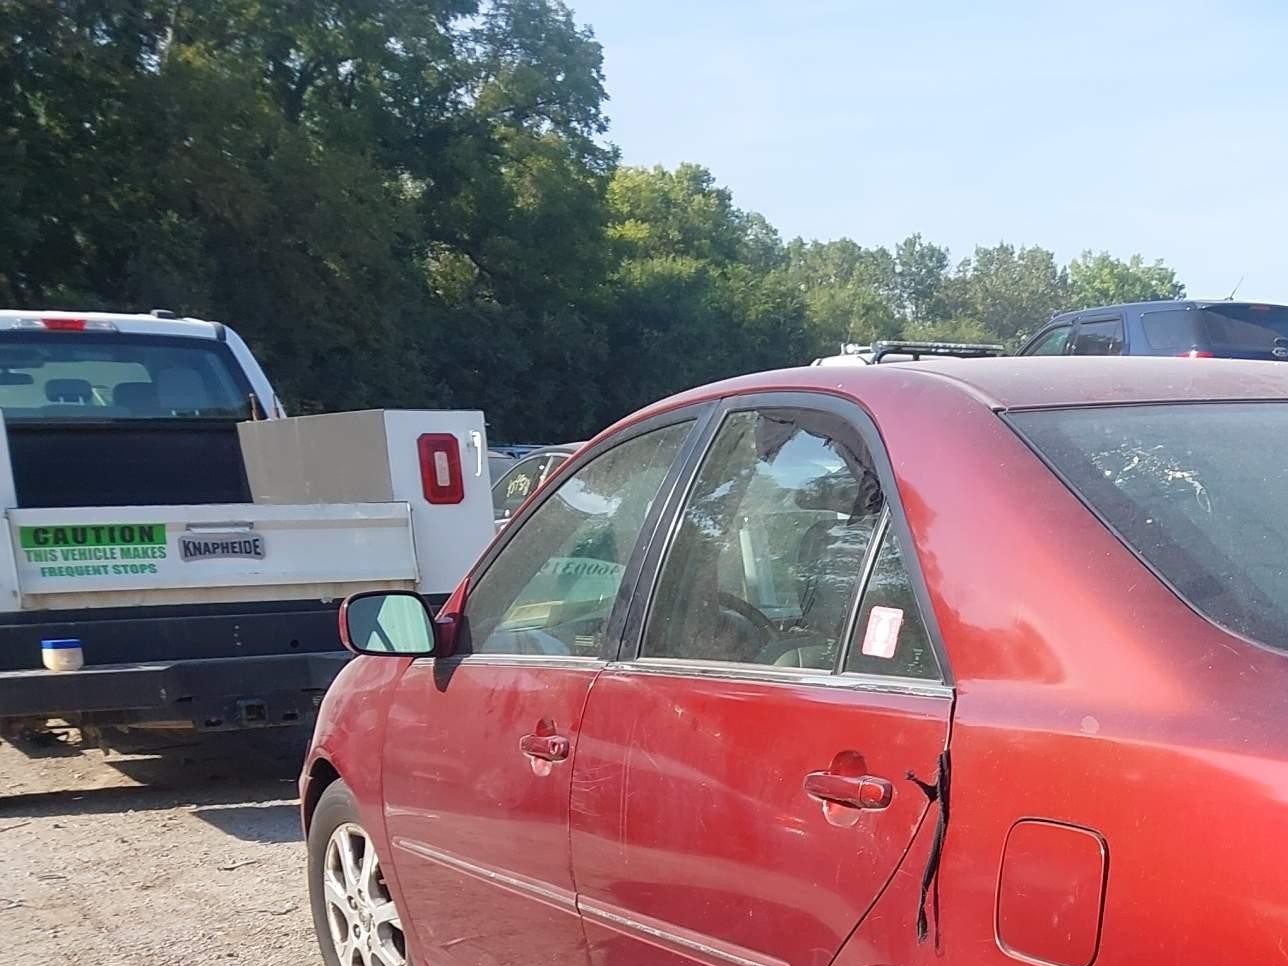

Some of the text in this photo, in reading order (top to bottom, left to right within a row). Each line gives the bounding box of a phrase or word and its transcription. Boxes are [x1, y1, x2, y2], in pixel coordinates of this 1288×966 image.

[33, 525, 154, 545] CAUTION
[24, 546, 167, 562] THIS VEHICLE MAKES
[183, 538, 261, 557] KNAPHEIDE
[40, 563, 158, 577] FREQUENT STOPS
